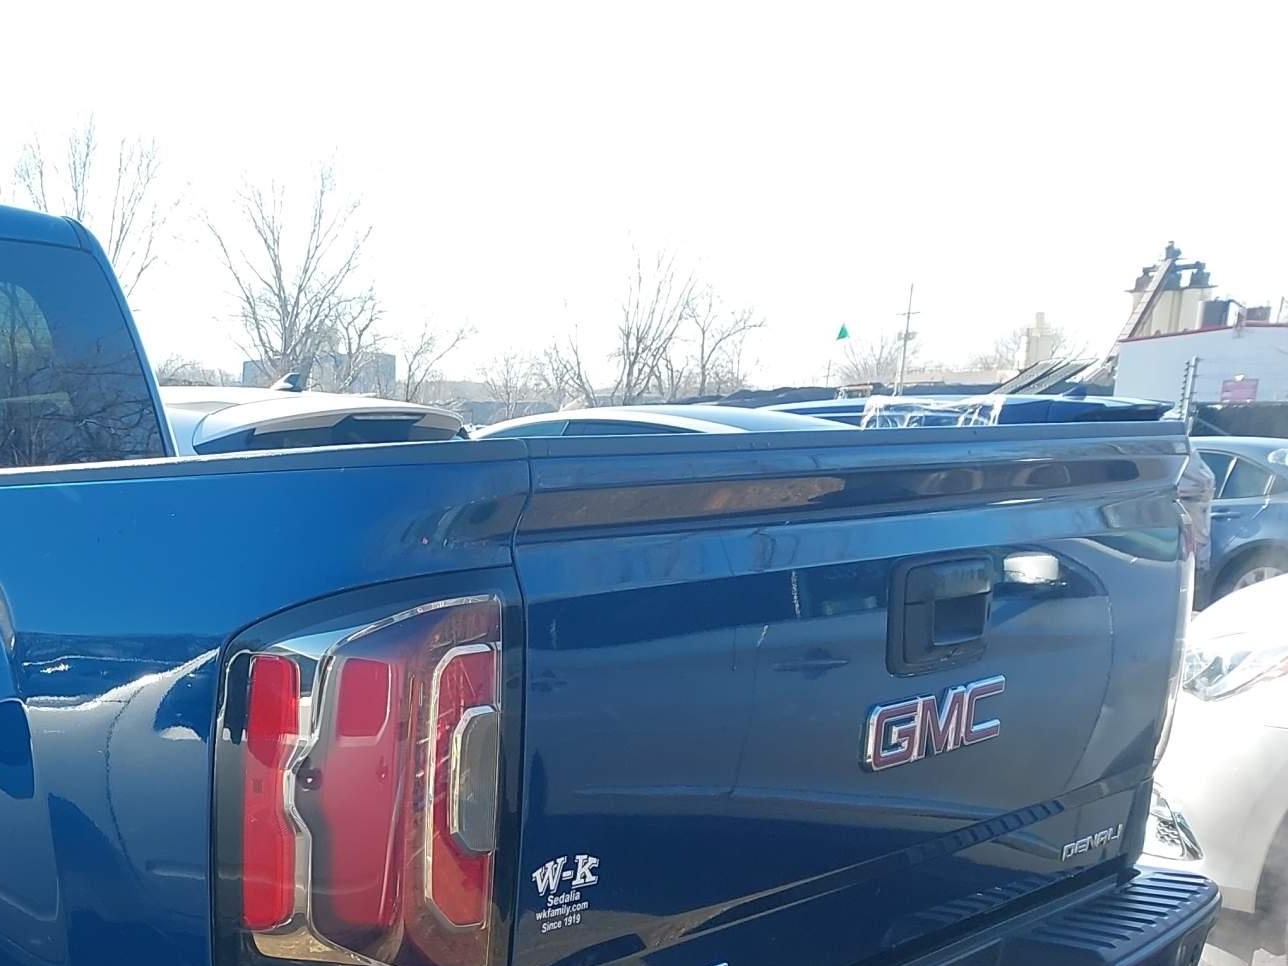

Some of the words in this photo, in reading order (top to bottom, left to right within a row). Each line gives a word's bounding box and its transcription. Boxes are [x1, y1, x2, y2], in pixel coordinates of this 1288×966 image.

[861, 674, 1006, 771] GMC
[1062, 824, 1123, 861] DENALI
[532, 855, 599, 896] W-K
[536, 902, 588, 920] wkfamily.com
[547, 890, 580, 906] Sedalia
[541, 921, 562, 933] Since
[564, 914, 581, 926] 1919
